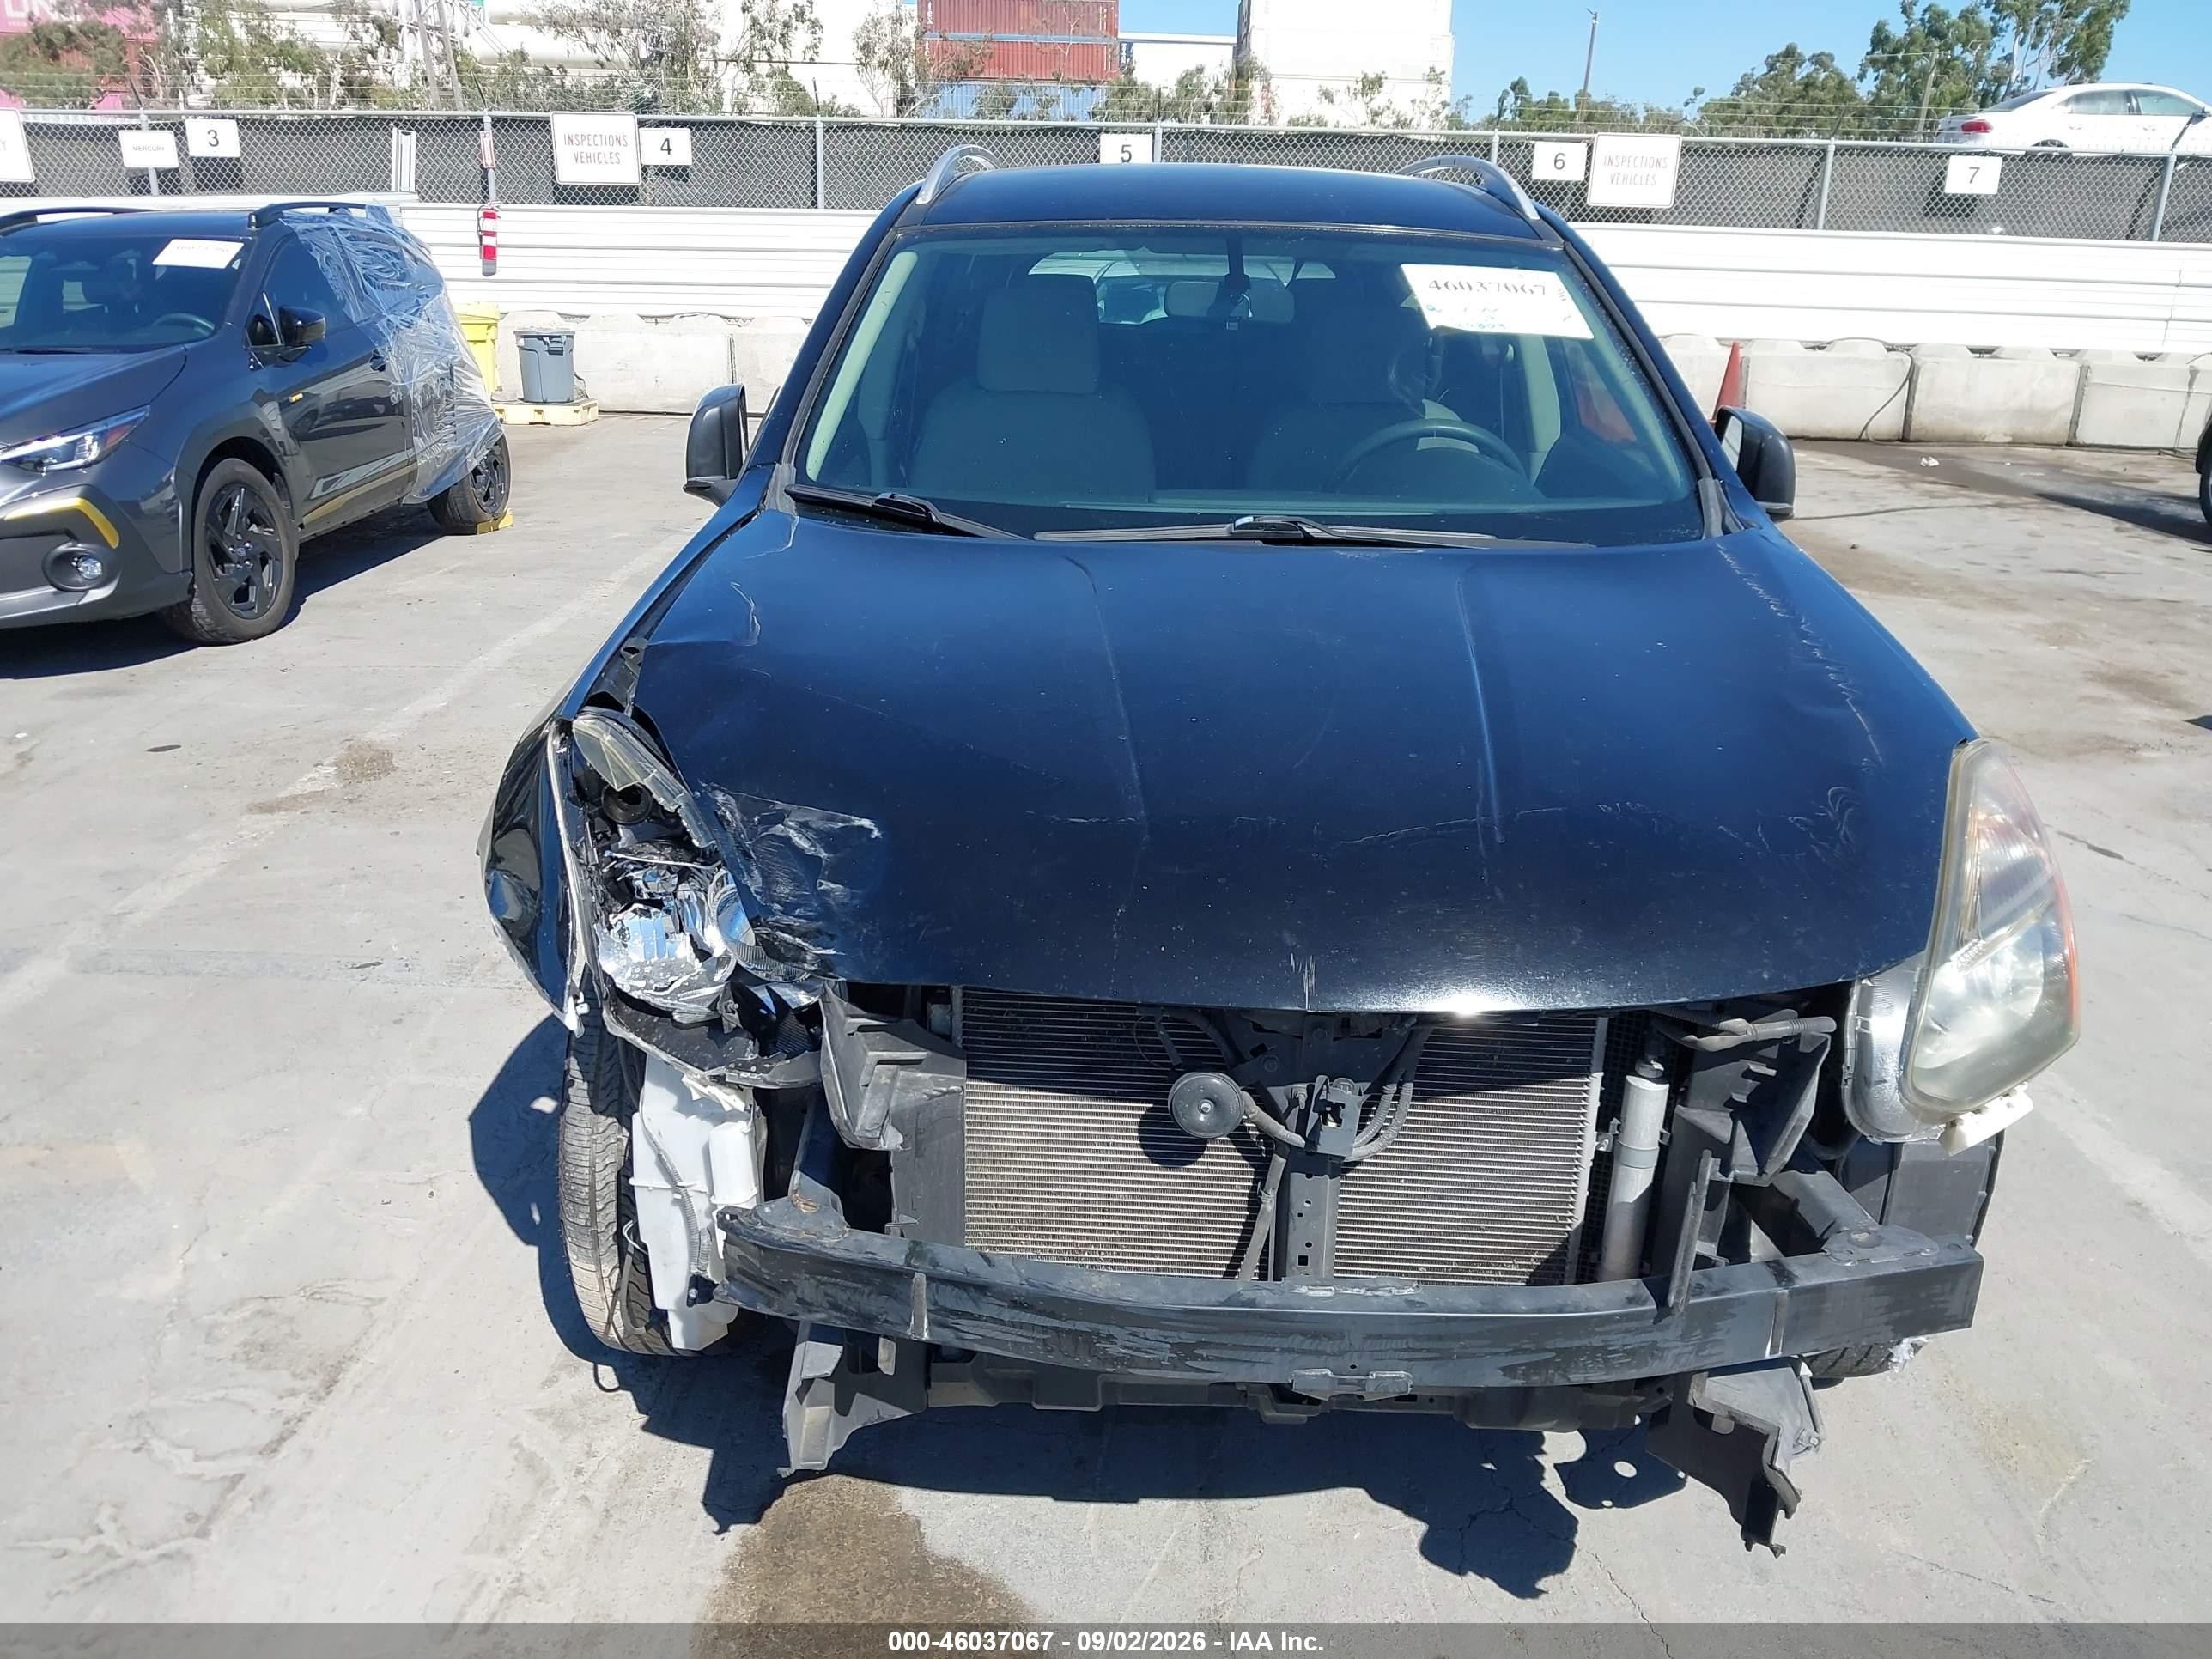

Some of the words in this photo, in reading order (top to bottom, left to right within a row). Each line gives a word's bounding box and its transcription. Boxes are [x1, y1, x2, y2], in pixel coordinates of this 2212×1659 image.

[207, 130, 220, 147] 3
[563, 133, 629, 147] INSPECTIONS
[660, 137, 672, 155] 4
[574, 150, 621, 164] VEHICLES
[1121, 144, 1133, 163] 5
[1553, 152, 1566, 170] 6
[1603, 155, 1668, 169] INSPECTIONS
[1610, 173, 1656, 186] VEHICLES
[1969, 167, 1980, 184] 7
[1429, 279, 1547, 296] 46037067
